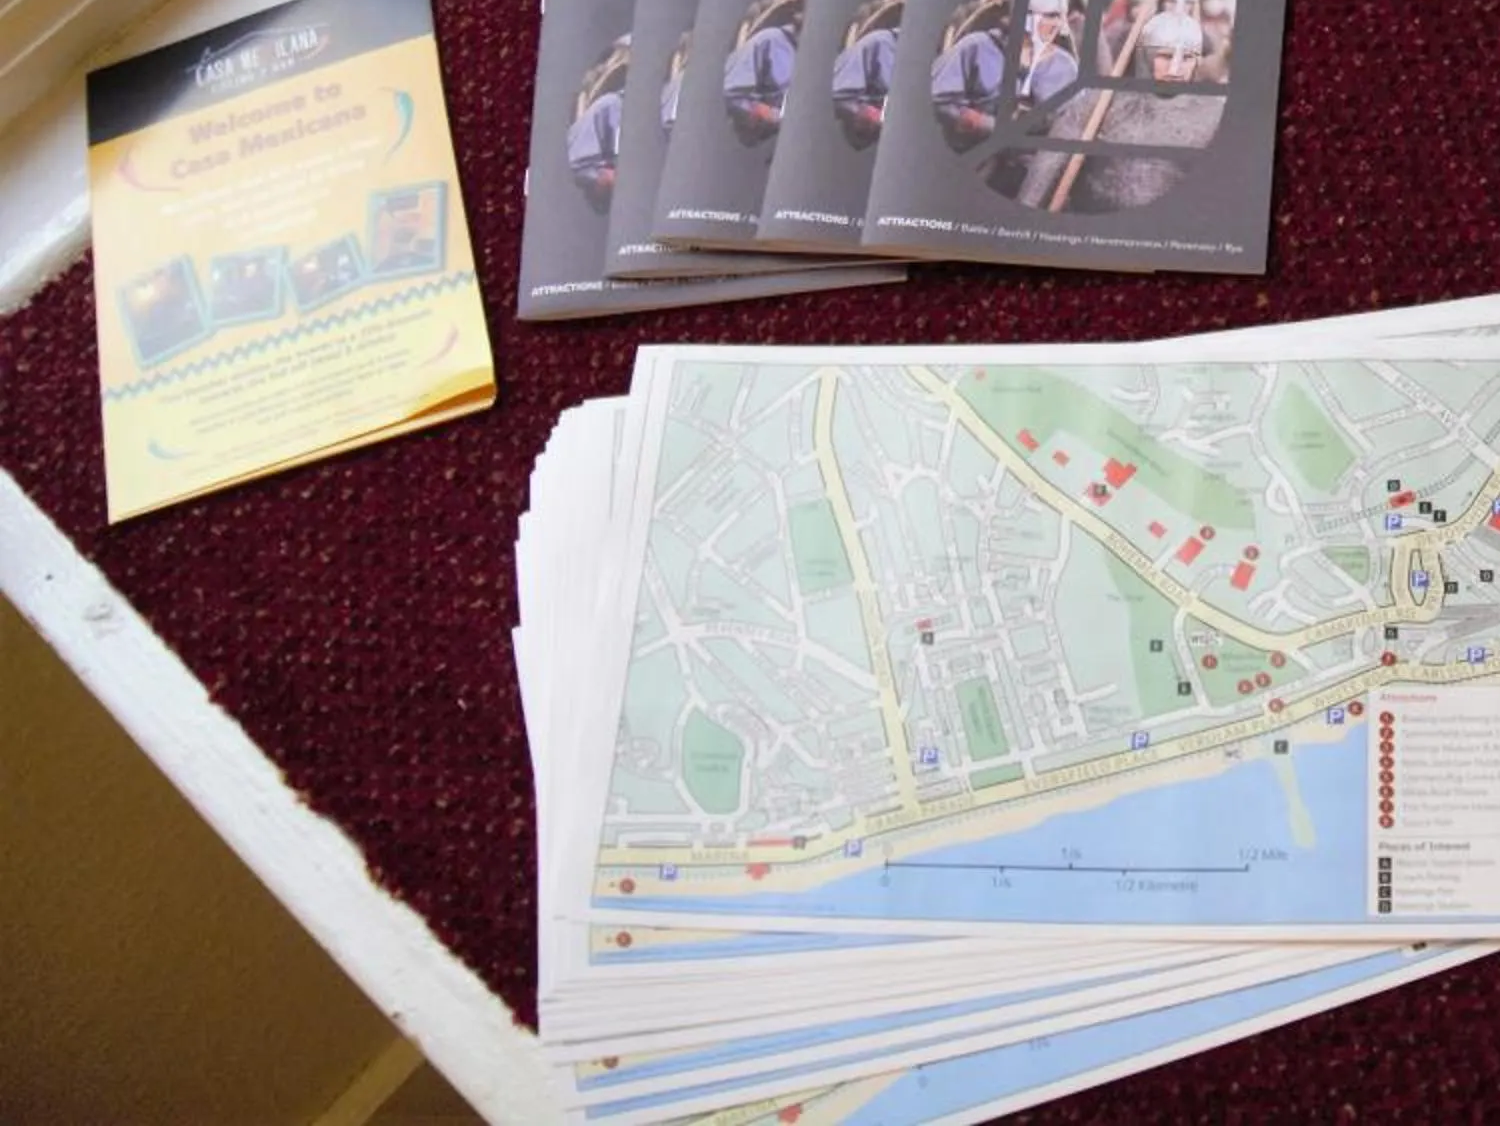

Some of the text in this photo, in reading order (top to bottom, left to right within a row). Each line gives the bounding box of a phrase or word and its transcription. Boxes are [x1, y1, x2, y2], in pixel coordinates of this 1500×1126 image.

[188, 82, 343, 144] Welcome to
[170, 104, 368, 180] Casa Mexicana
[775, 210, 849, 226] ATTRACTIONS
[877, 216, 954, 231] ATTRACTIONS
